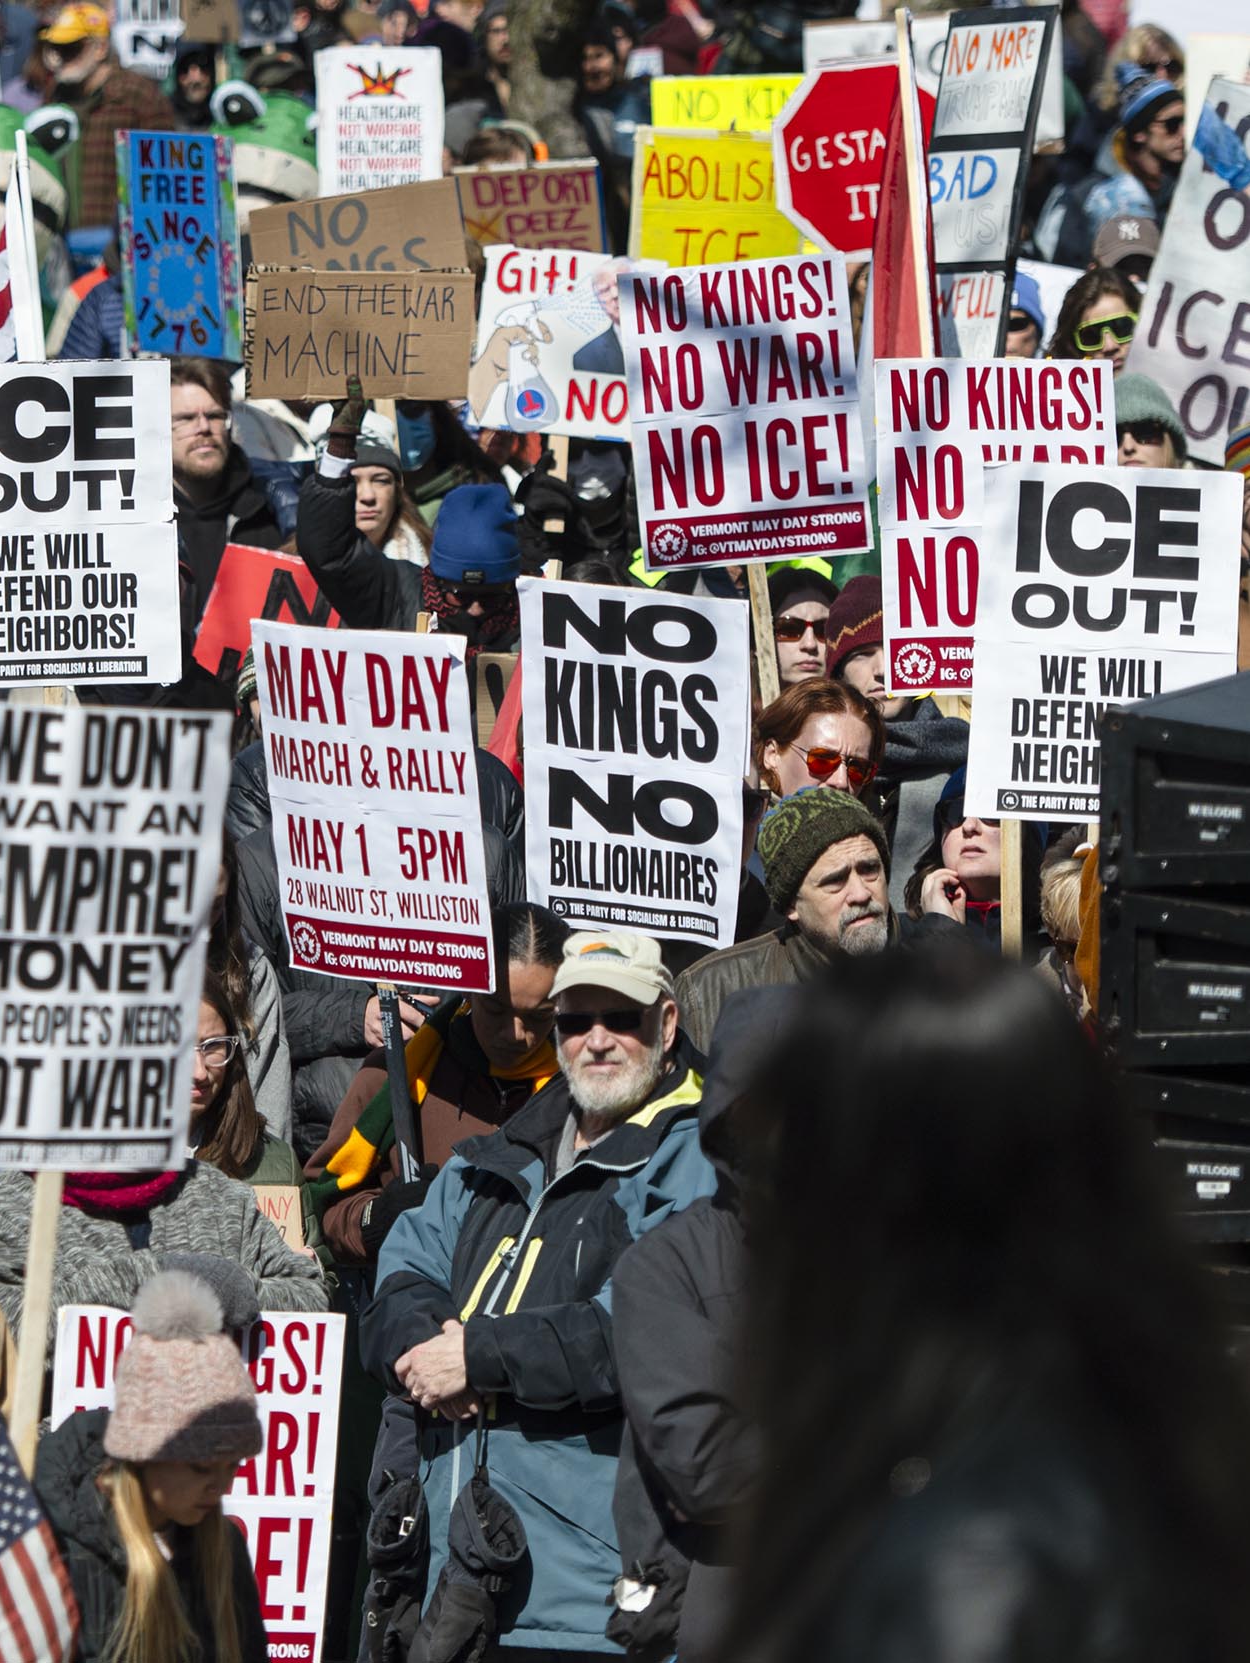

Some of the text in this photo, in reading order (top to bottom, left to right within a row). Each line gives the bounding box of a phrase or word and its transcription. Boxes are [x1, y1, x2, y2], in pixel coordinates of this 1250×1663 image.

[948, 25, 1036, 76] NO MORE
[338, 105, 421, 121] HEALTHCARE
[673, 88, 719, 122] NO
[138, 139, 204, 169] KING
[338, 123, 421, 137] NOT WARFARE
[338, 139, 421, 155] HEALTHCARE
[338, 157, 421, 171] NOT WARFARE
[930, 154, 998, 204] BAD
[140, 174, 206, 205] FREE
[472, 170, 595, 208] DEPORT
[134, 210, 214, 265] SINCE
[287, 198, 368, 256] NO
[505, 208, 590, 236] DEEZ
[496, 251, 577, 295] Git!
[633, 259, 837, 334] NO KINGS!
[264, 285, 325, 315] END
[263, 329, 425, 381] MACHINE
[639, 329, 845, 415] NO WAR!
[566, 379, 628, 425] NO
[890, 366, 1105, 432] NO KINGS!
[648, 413, 853, 511] NO ICE!
[691, 511, 862, 538] VERMONT MAY DAY STRONG
[710, 531, 837, 555] @VTMAYDAYSTRONG
[1015, 480, 1201, 581] ICE
[44, 533, 112, 571] WILL
[81, 572, 137, 609] OUR
[1011, 582, 1198, 636] OUT!
[542, 591, 718, 663] NO
[0, 664, 25, 677] PARTY
[26, 663, 42, 675] FOR
[43, 661, 86, 675] SOCIALISM
[87, 661, 94, 673] &
[96, 660, 142, 673] LIBERATION
[264, 641, 451, 733] MAY DAY
[544, 656, 720, 763] KINGS
[80, 713, 213, 792] DON'T
[269, 731, 467, 795] MARCH & RALLY
[139, 803, 204, 836] AN
[548, 766, 720, 845] NO
[550, 837, 719, 907] BILLIONAIRES
[0, 1003, 113, 1048] PEOPLE'S
[119, 1004, 183, 1048] NEEDS
[59, 1056, 177, 1131] WAR!
